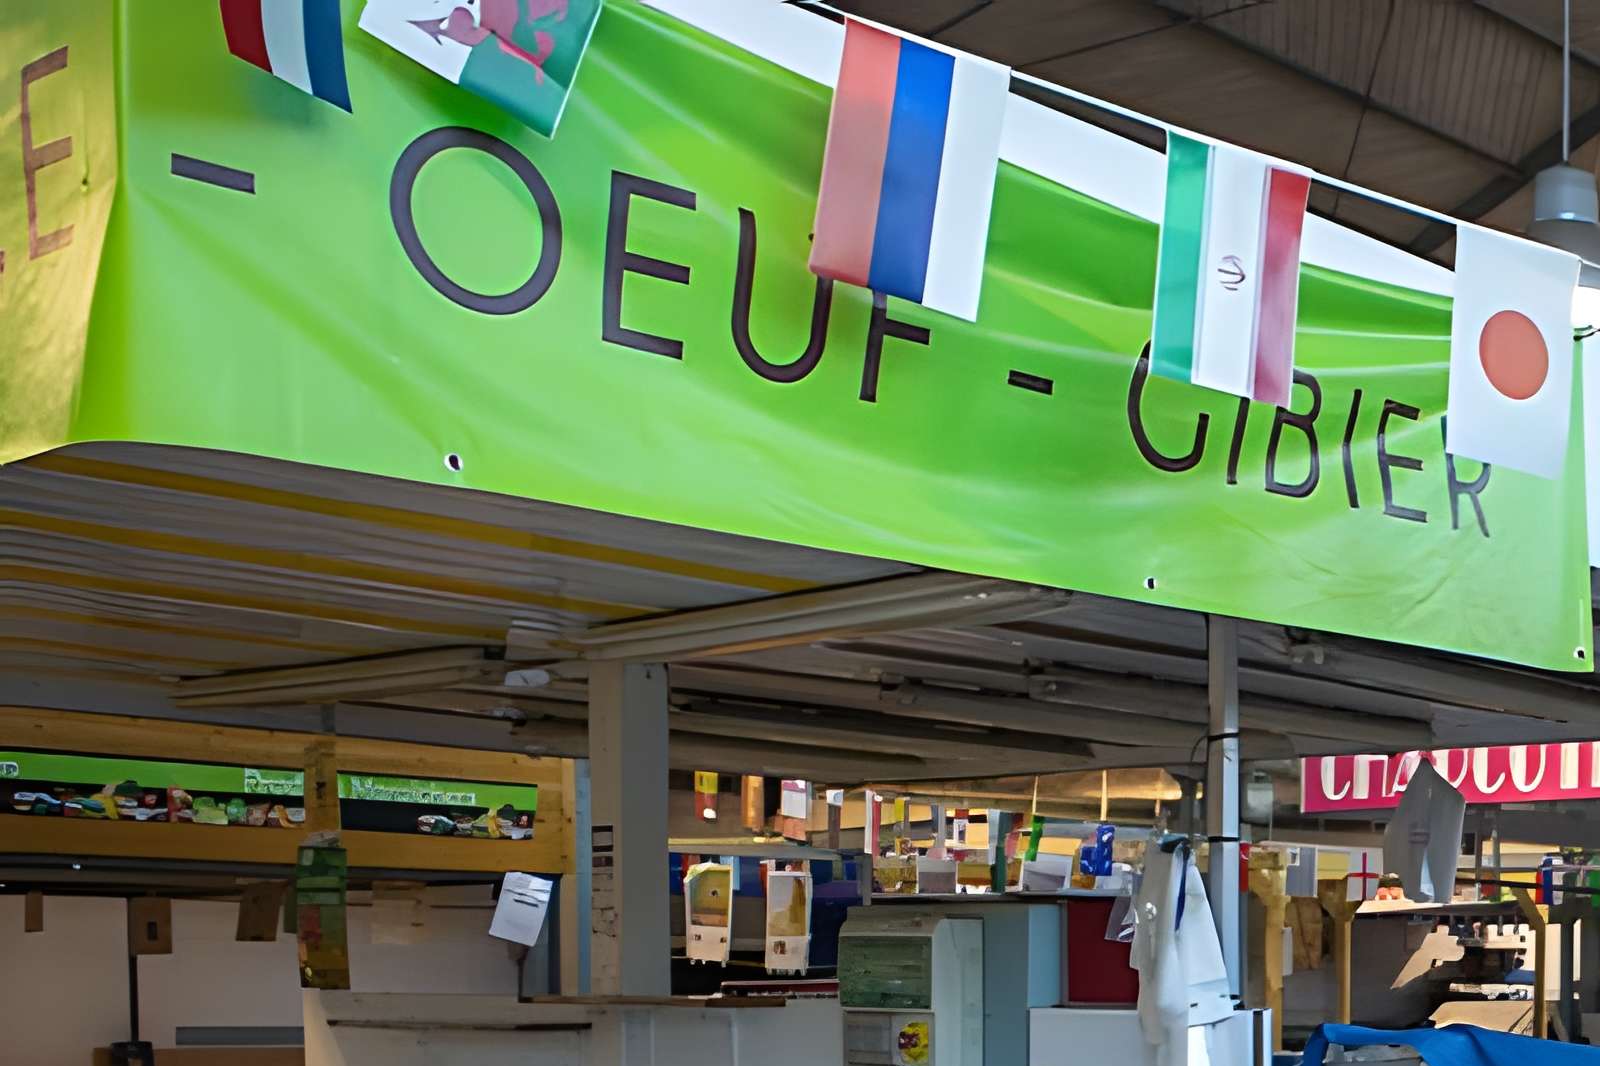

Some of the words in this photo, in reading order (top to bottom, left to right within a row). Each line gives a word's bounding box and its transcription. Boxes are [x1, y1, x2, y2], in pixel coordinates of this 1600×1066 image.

[0, 45, 75, 272] E
[389, 126, 931, 404] OEUF
[1127, 339, 1492, 538] GIBIER
